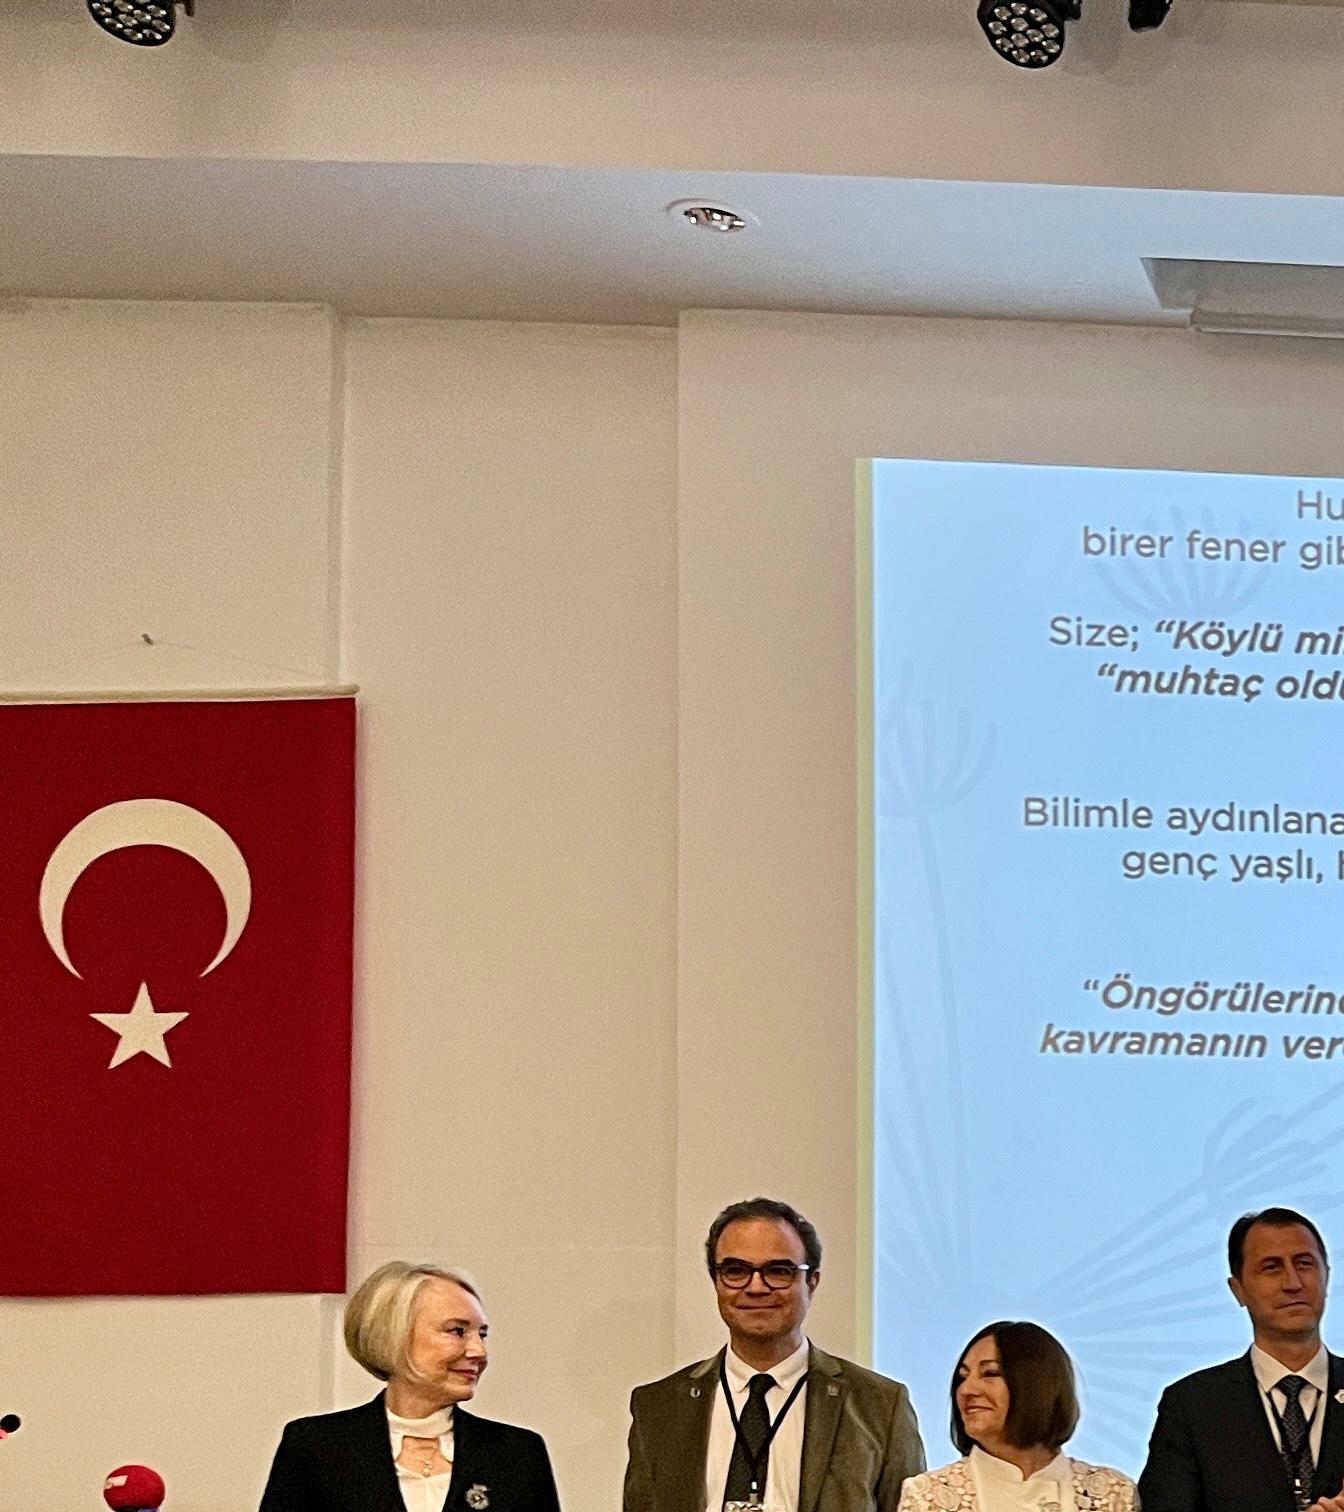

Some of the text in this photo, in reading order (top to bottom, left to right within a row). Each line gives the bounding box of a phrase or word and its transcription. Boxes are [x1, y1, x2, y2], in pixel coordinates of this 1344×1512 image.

[1083, 524, 1174, 559] birer
[1185, 529, 1288, 564] fener
[1048, 615, 1139, 653] Size;
[1023, 795, 1154, 830] Bilimle
[1122, 850, 1218, 882] genç
[1229, 847, 1324, 884] yaşlı,
[1039, 1022, 1268, 1058] kavramanın
